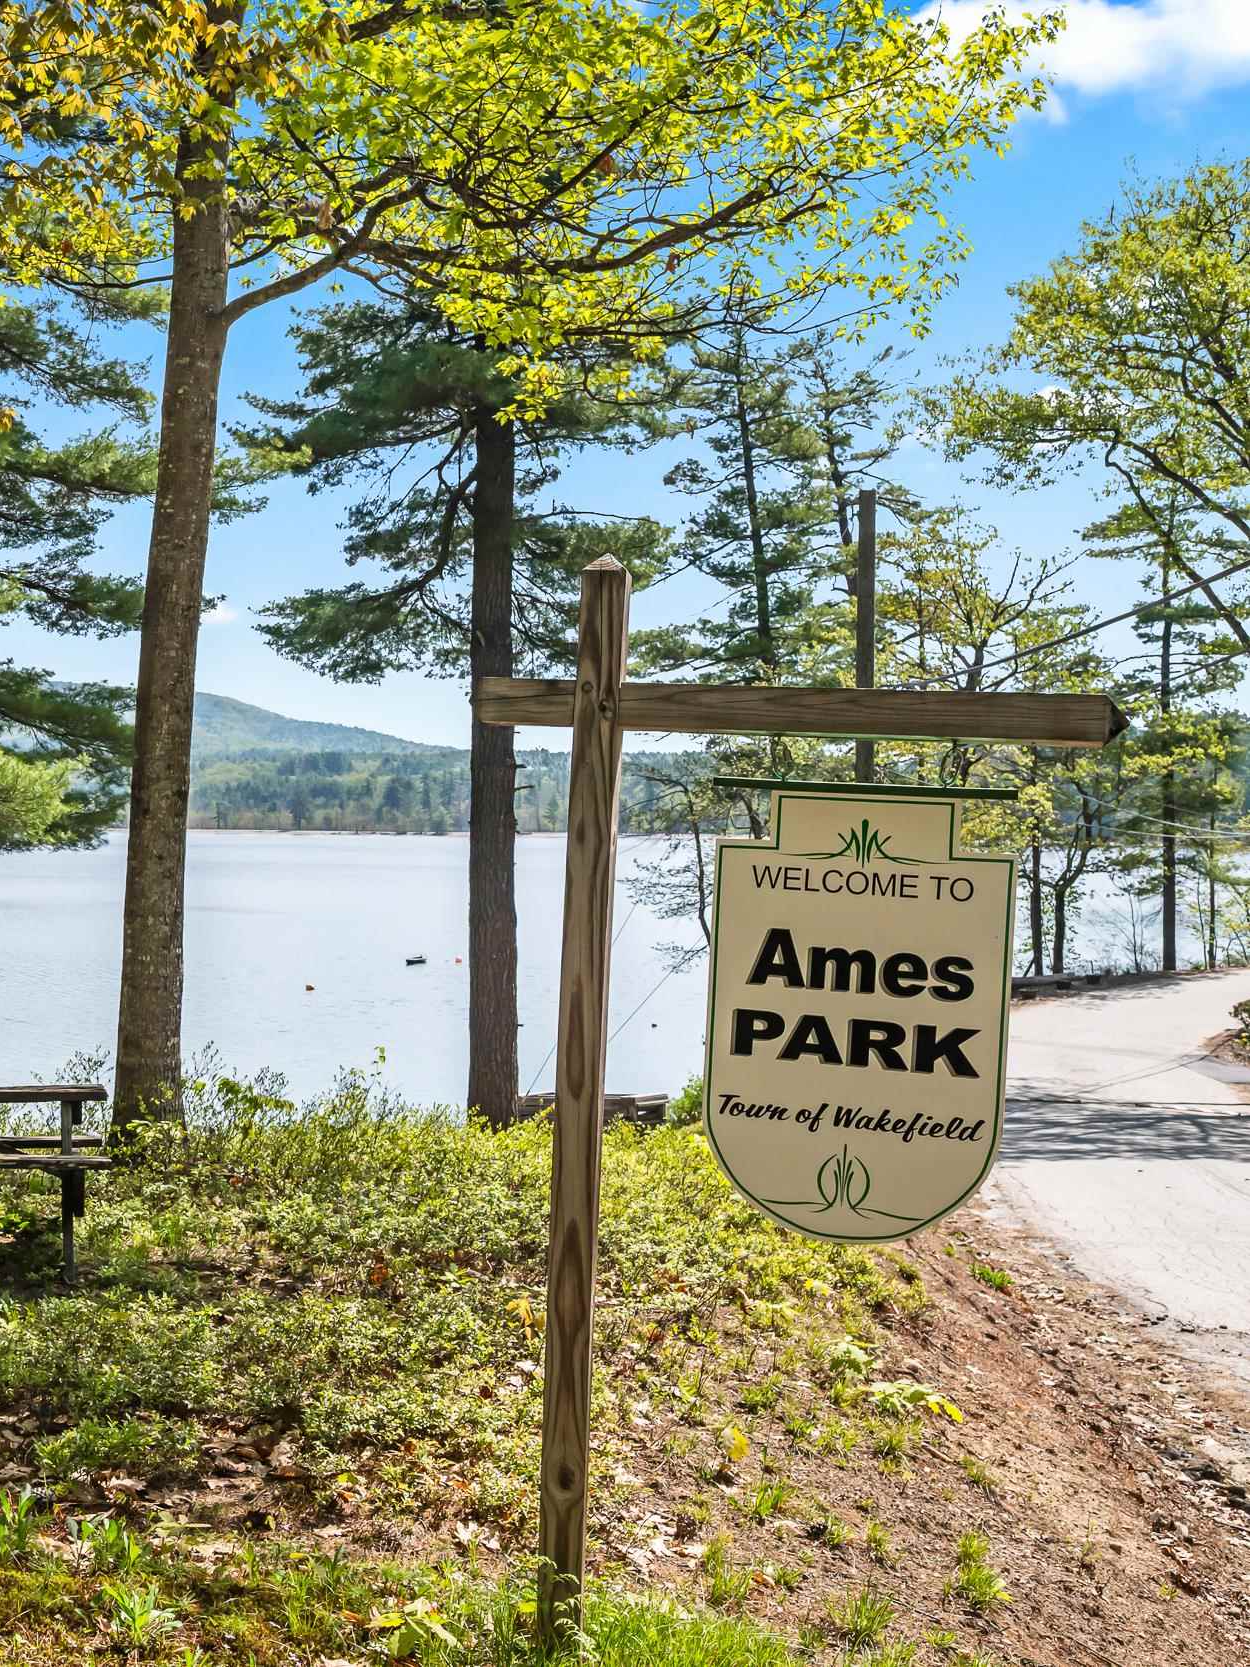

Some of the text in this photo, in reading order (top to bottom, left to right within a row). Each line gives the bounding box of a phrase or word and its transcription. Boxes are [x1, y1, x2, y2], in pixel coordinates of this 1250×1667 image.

[752, 864, 974, 902] WELCOME TO
[746, 928, 975, 1002] Ames
[730, 1008, 982, 1079] PARK
[718, 1094, 985, 1143] Town of Wakefield
